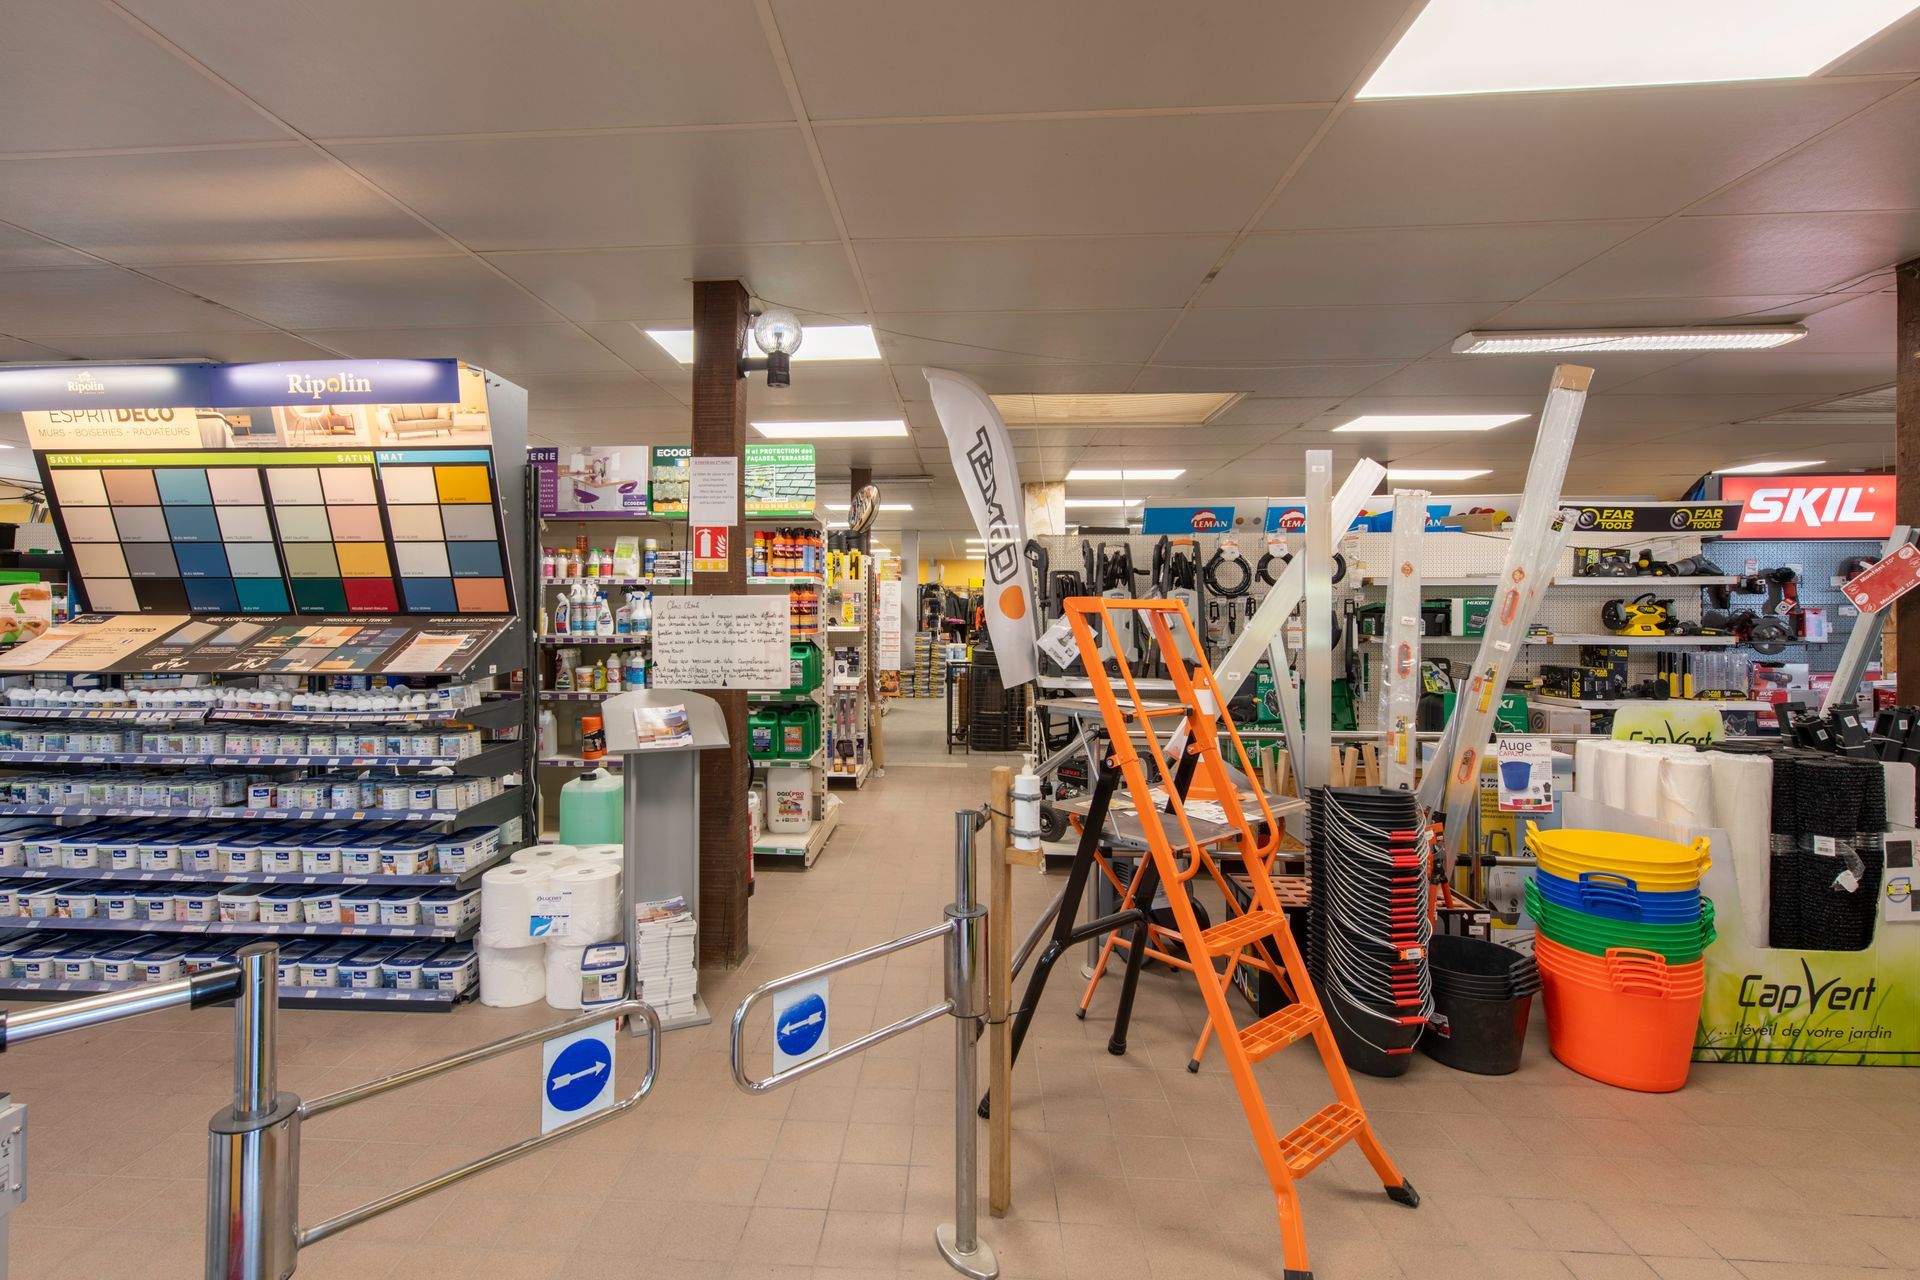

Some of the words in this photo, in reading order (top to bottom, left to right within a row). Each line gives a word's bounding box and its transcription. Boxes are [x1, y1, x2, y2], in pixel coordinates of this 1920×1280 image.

[67, 380, 104, 394] Ripolin
[288, 372, 372, 399] Ripolin
[38, 429, 65, 438] MURS
[75, 428, 123, 437] BOISERIES
[132, 428, 191, 436] RADIATEURS
[50, 456, 83, 464] SATIN
[336, 454, 371, 463] SATIN
[380, 453, 404, 461] MAT
[1744, 487, 1876, 527] SKIL
[1602, 509, 1635, 520] FAR
[1694, 509, 1724, 519] FAR
[1193, 520, 1229, 528] LEMAN
[1601, 522, 1633, 530] TOOLS
[1692, 521, 1721, 529] TOOLS
[1860, 564, 1886, 583] Montant
[1880, 587, 1905, 605] Montant
[1500, 700, 1515, 709] KI
[1499, 740, 1532, 753] Auge
[1738, 958, 1876, 1014] CapVert
[1782, 1023, 1801, 1037] de
[1807, 1028, 1844, 1038] votre
[1849, 1025, 1892, 1042] jardin
